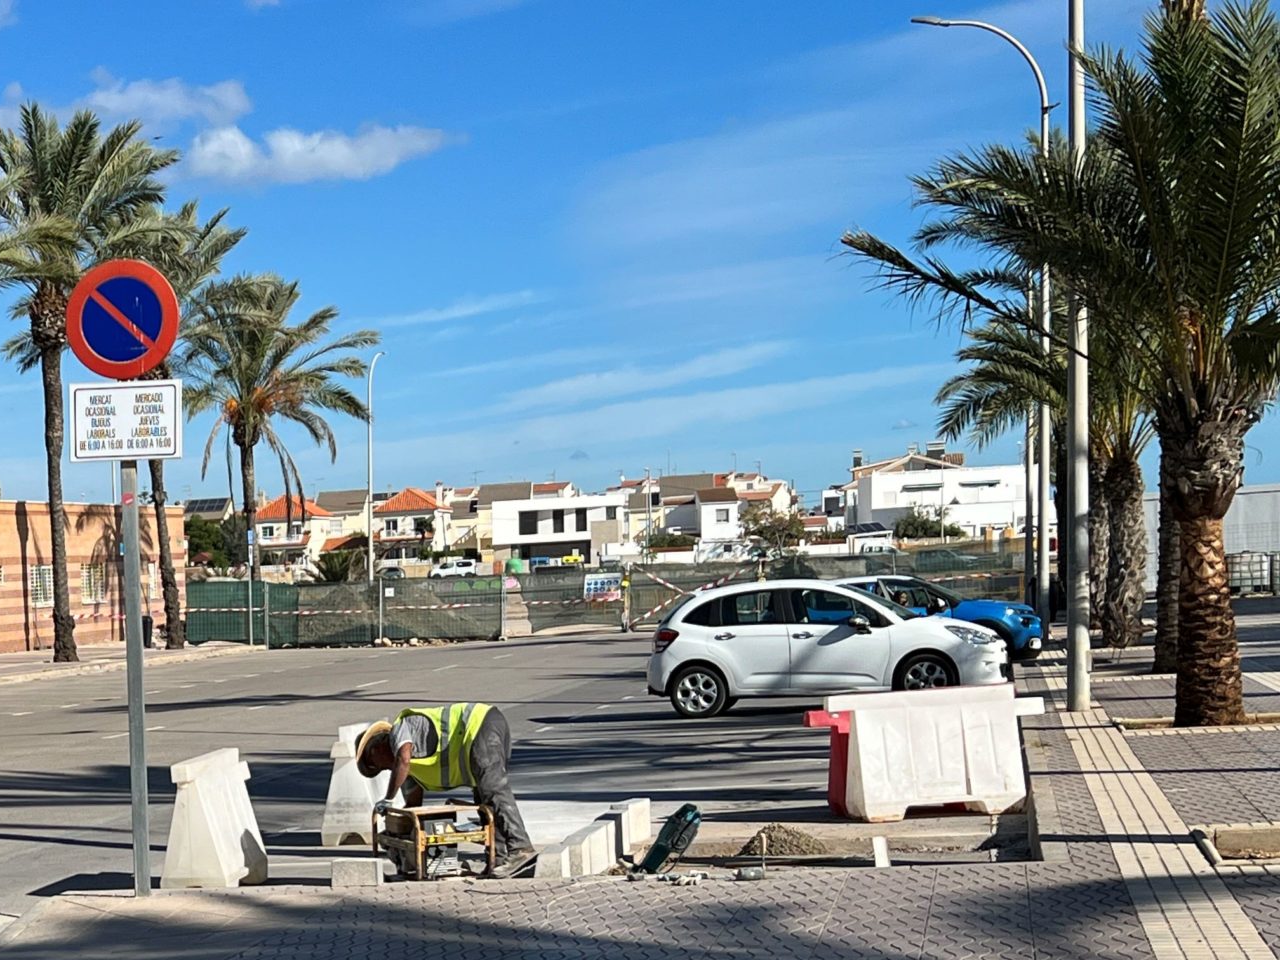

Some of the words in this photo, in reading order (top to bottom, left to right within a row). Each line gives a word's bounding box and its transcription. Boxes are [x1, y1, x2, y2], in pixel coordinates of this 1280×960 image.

[90, 395, 112, 405] MERCAT
[135, 393, 162, 403] MERCADO
[85, 406, 116, 416] OCASIONAL
[134, 405, 164, 414] OCASIONAL
[139, 416, 159, 425] JUEVES
[87, 429, 115, 439] LABORALS
[132, 427, 167, 437] LABORABLES
[80, 441, 86, 450] DE
[88, 440, 100, 450] 6:00
[102, 440, 106, 449] A
[108, 439, 123, 449] 16:00
[127, 439, 134, 449] DE
[136, 439, 148, 448] 6:00
[150, 438, 154, 448] A
[156, 437, 171, 447] 16:00
